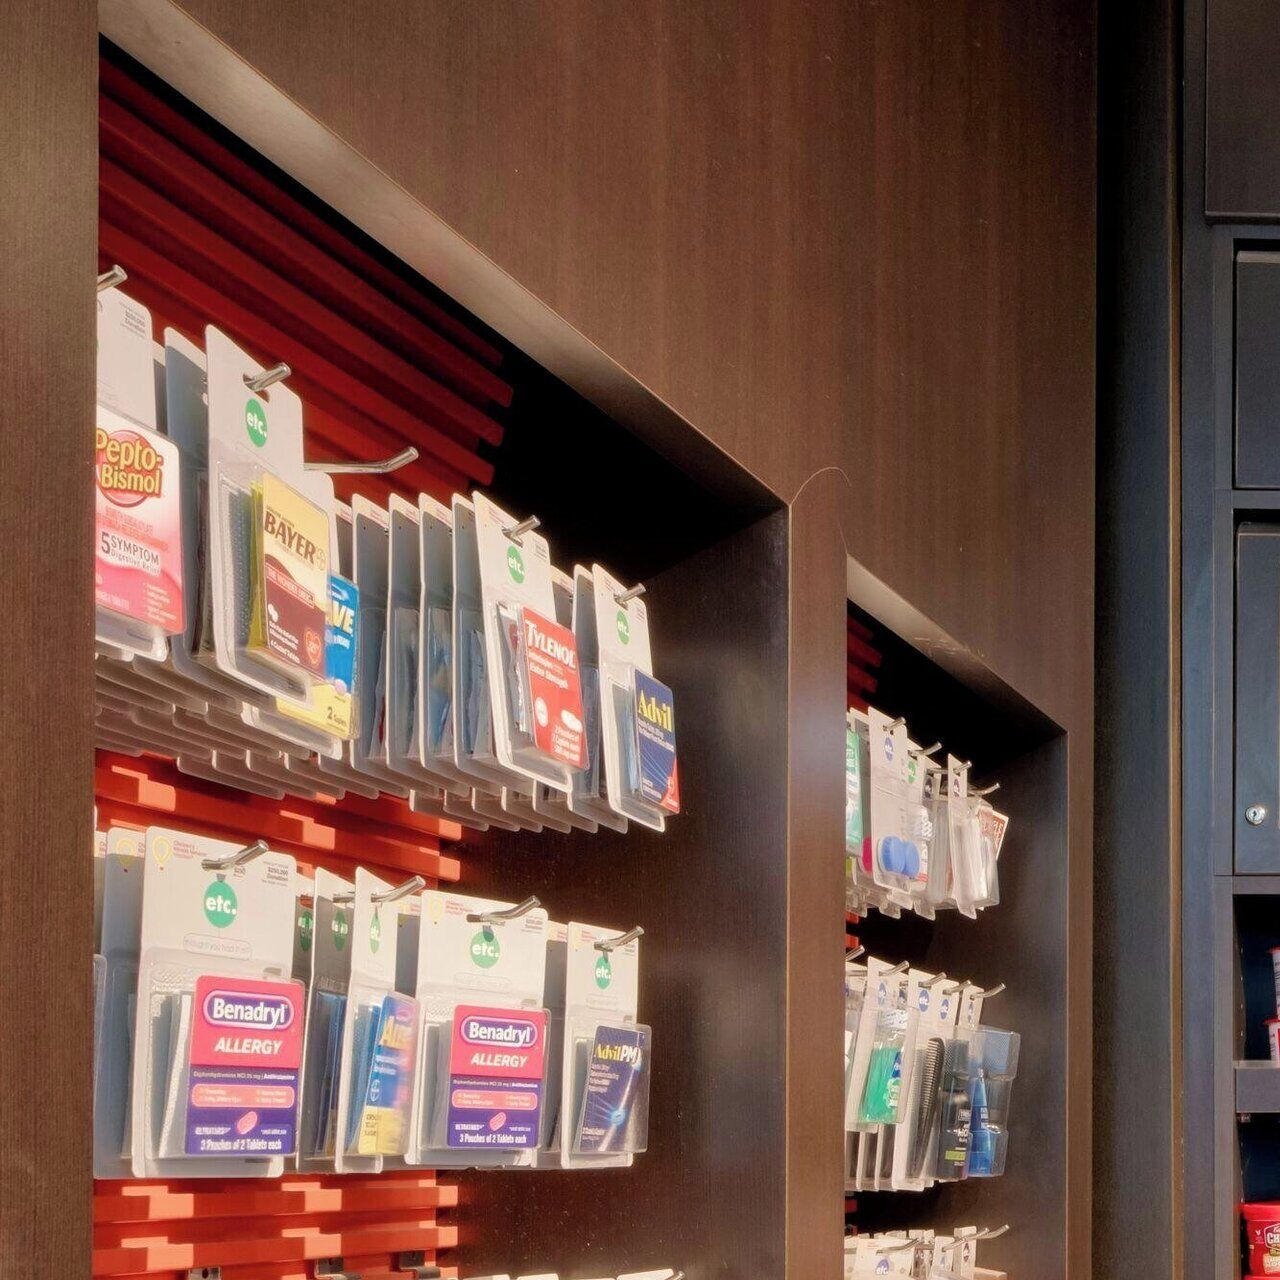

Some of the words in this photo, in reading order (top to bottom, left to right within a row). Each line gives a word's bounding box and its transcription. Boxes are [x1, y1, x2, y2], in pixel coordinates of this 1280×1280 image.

[100, 464, 162, 497] Bismol
[265, 510, 315, 564] BAYER
[101, 532, 112, 554] 5
[111, 536, 160, 566] SYMPTOM
[509, 556, 525, 576] etc.
[526, 621, 577, 669] TYLENOL
[639, 690, 672, 732] Advil
[206, 895, 237, 915] etc.
[472, 943, 499, 957] etc.
[595, 967, 612, 979] etc.
[212, 998, 286, 1029] Benadryl
[469, 1022, 531, 1047] Benadryl
[215, 1037, 283, 1055] ALLERGY
[471, 1053, 528, 1068] ALLERGY
[464, 1133, 484, 1144] Pouches
